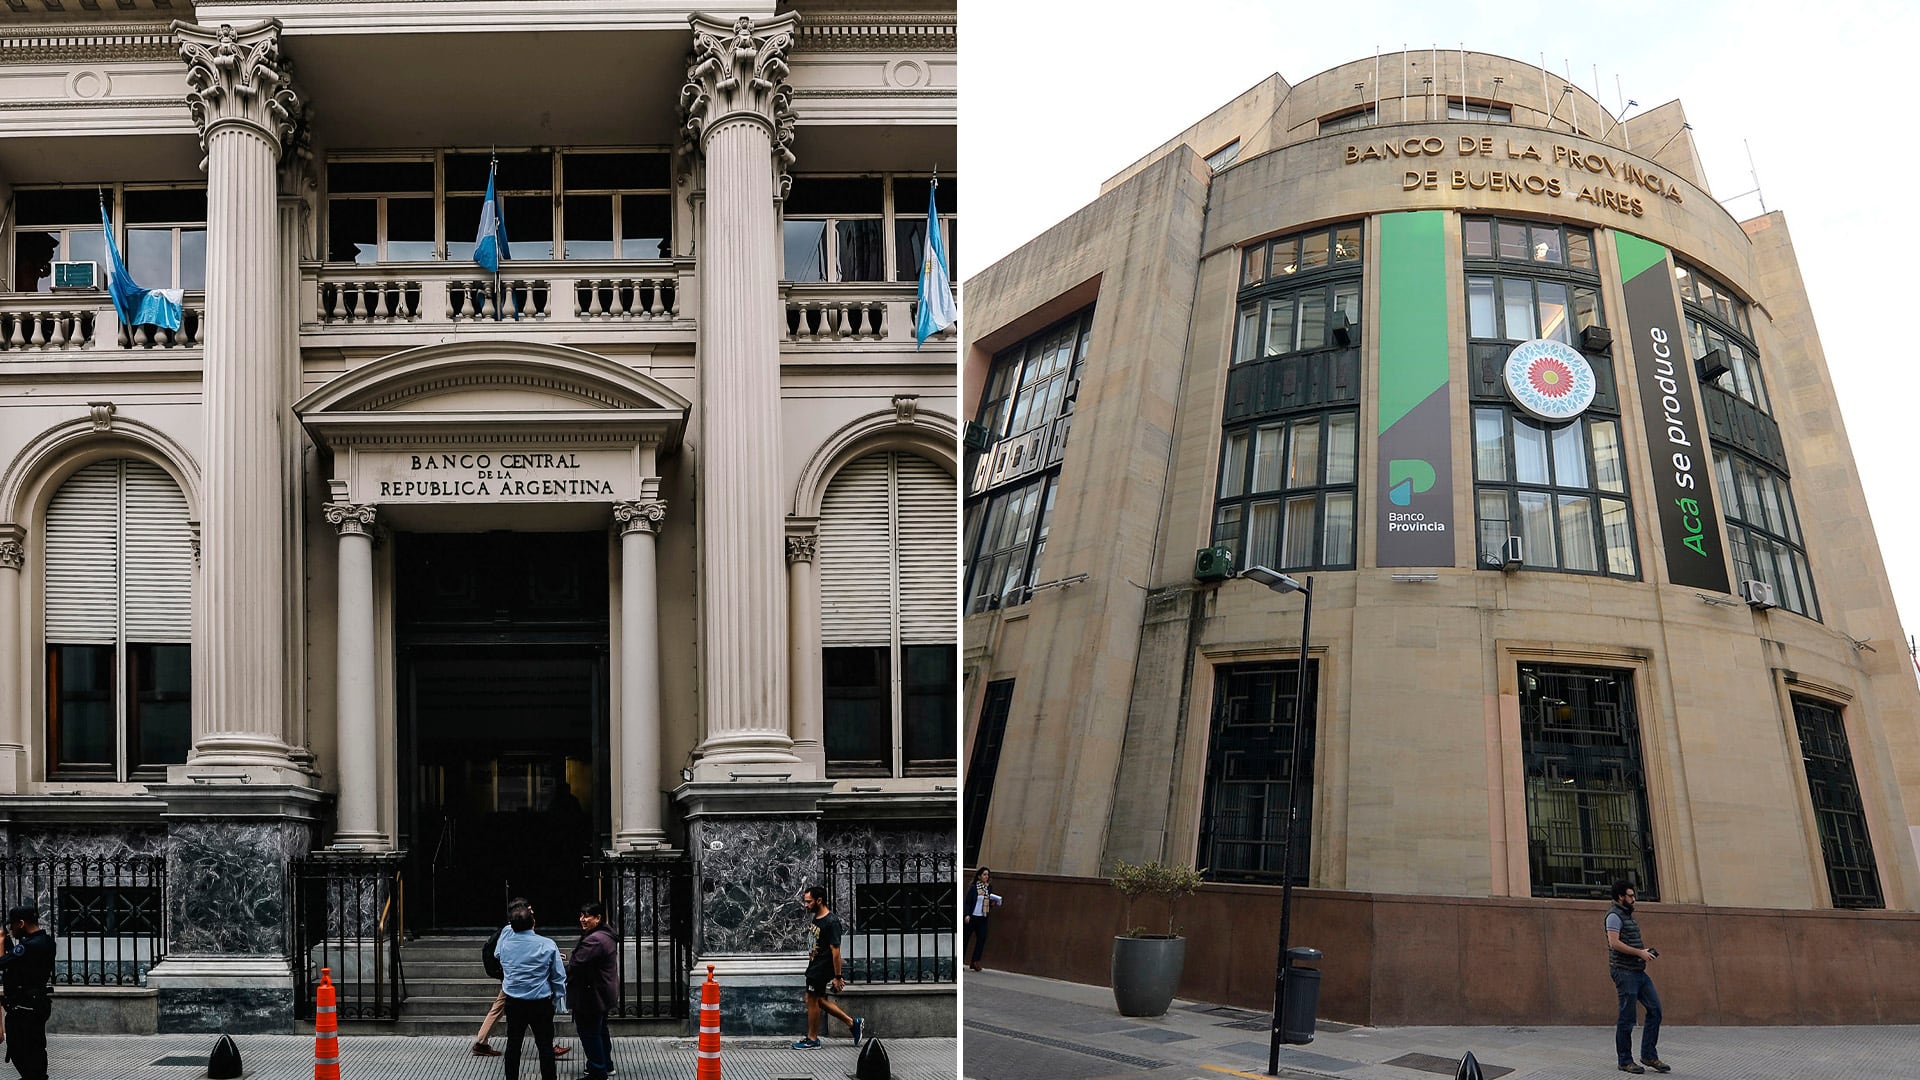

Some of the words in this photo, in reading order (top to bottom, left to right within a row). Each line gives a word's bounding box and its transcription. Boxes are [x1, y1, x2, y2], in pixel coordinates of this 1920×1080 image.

[1345, 136, 1445, 165] BANCO
[1458, 135, 1493, 157] DE
[1506, 139, 1542, 162] LA
[1553, 144, 1684, 204] PROVINCIA
[1403, 170, 1438, 191] DE
[1451, 169, 1563, 198] BUENOS
[1576, 185, 1645, 218] AIRES
[1650, 327, 1692, 447] produce
[411, 454, 491, 470] BANCO
[500, 454, 581, 469] CENTRAL
[478, 470, 493, 480] DE
[497, 470, 512, 480] LA
[1672, 453, 1696, 490] se
[381, 481, 490, 496] REPUBLICA
[500, 480, 615, 495] ARGENTINA
[1388, 512, 1425, 522] Banco
[1388, 522, 1445, 532] Provincia
[1675, 498, 1708, 557] Acá
